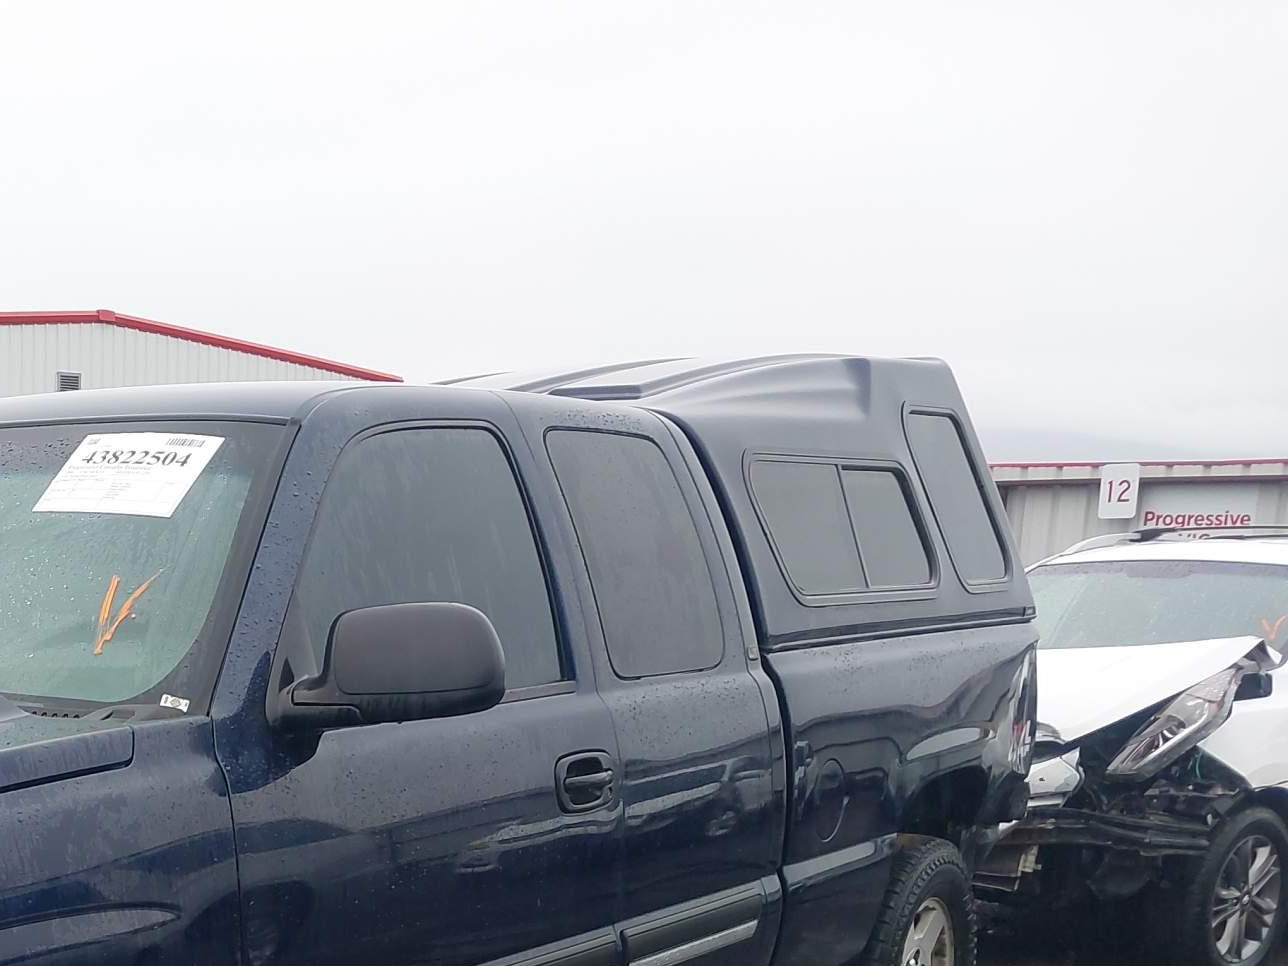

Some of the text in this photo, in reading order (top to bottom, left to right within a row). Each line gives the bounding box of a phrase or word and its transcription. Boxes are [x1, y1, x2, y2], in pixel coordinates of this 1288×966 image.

[82, 450, 192, 467] 43822504
[1107, 479, 1131, 503] 12
[1144, 511, 1251, 528] Progressive
